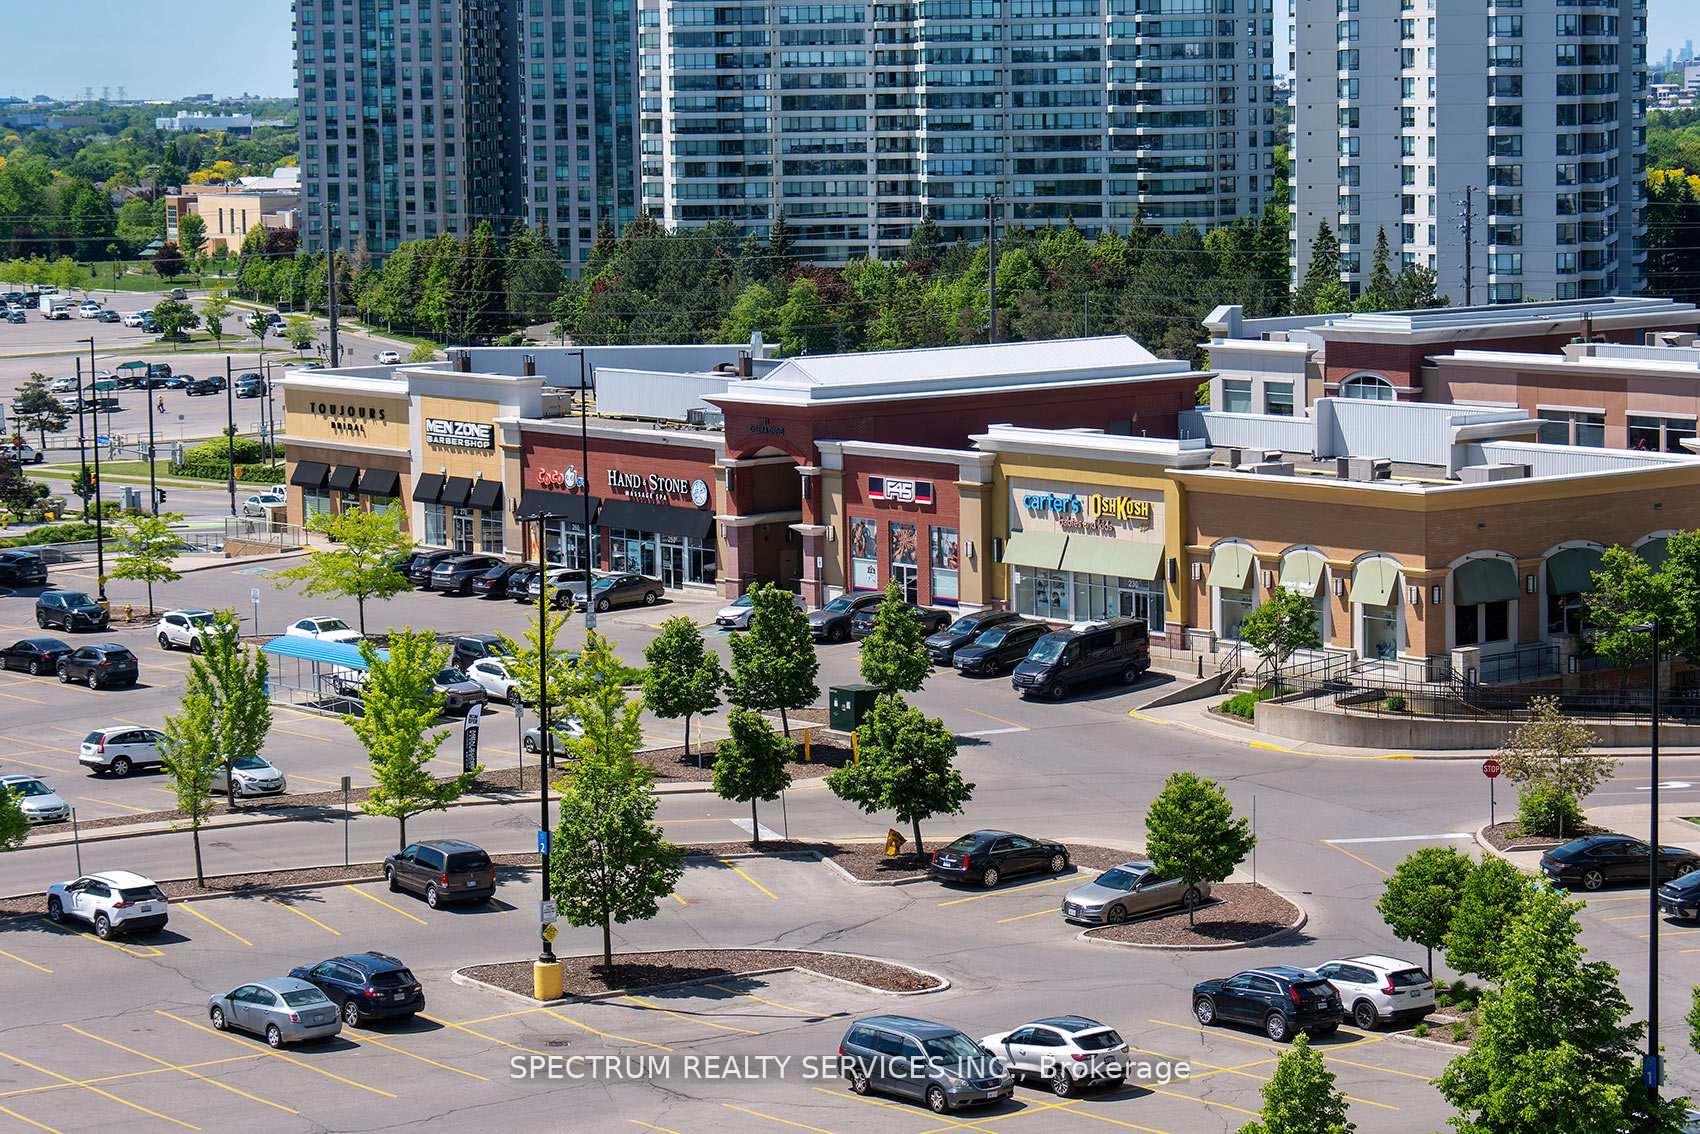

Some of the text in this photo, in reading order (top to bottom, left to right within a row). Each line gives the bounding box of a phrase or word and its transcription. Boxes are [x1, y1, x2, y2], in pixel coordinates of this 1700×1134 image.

[310, 402, 385, 420] TOUJOURS
[331, 421, 365, 432] BRIDAL
[426, 419, 492, 438] MEN ZONE
[426, 435, 490, 448] BARBERSHOP
[607, 469, 641, 488] HAND
[649, 474, 688, 494] STONE
[625, 490, 653, 499] MASSAGE
[886, 480, 912, 500] F45
[1023, 494, 1080, 514] carter's
[540, 842, 545, 852] 2
[1647, 1072, 1652, 1085] 1
